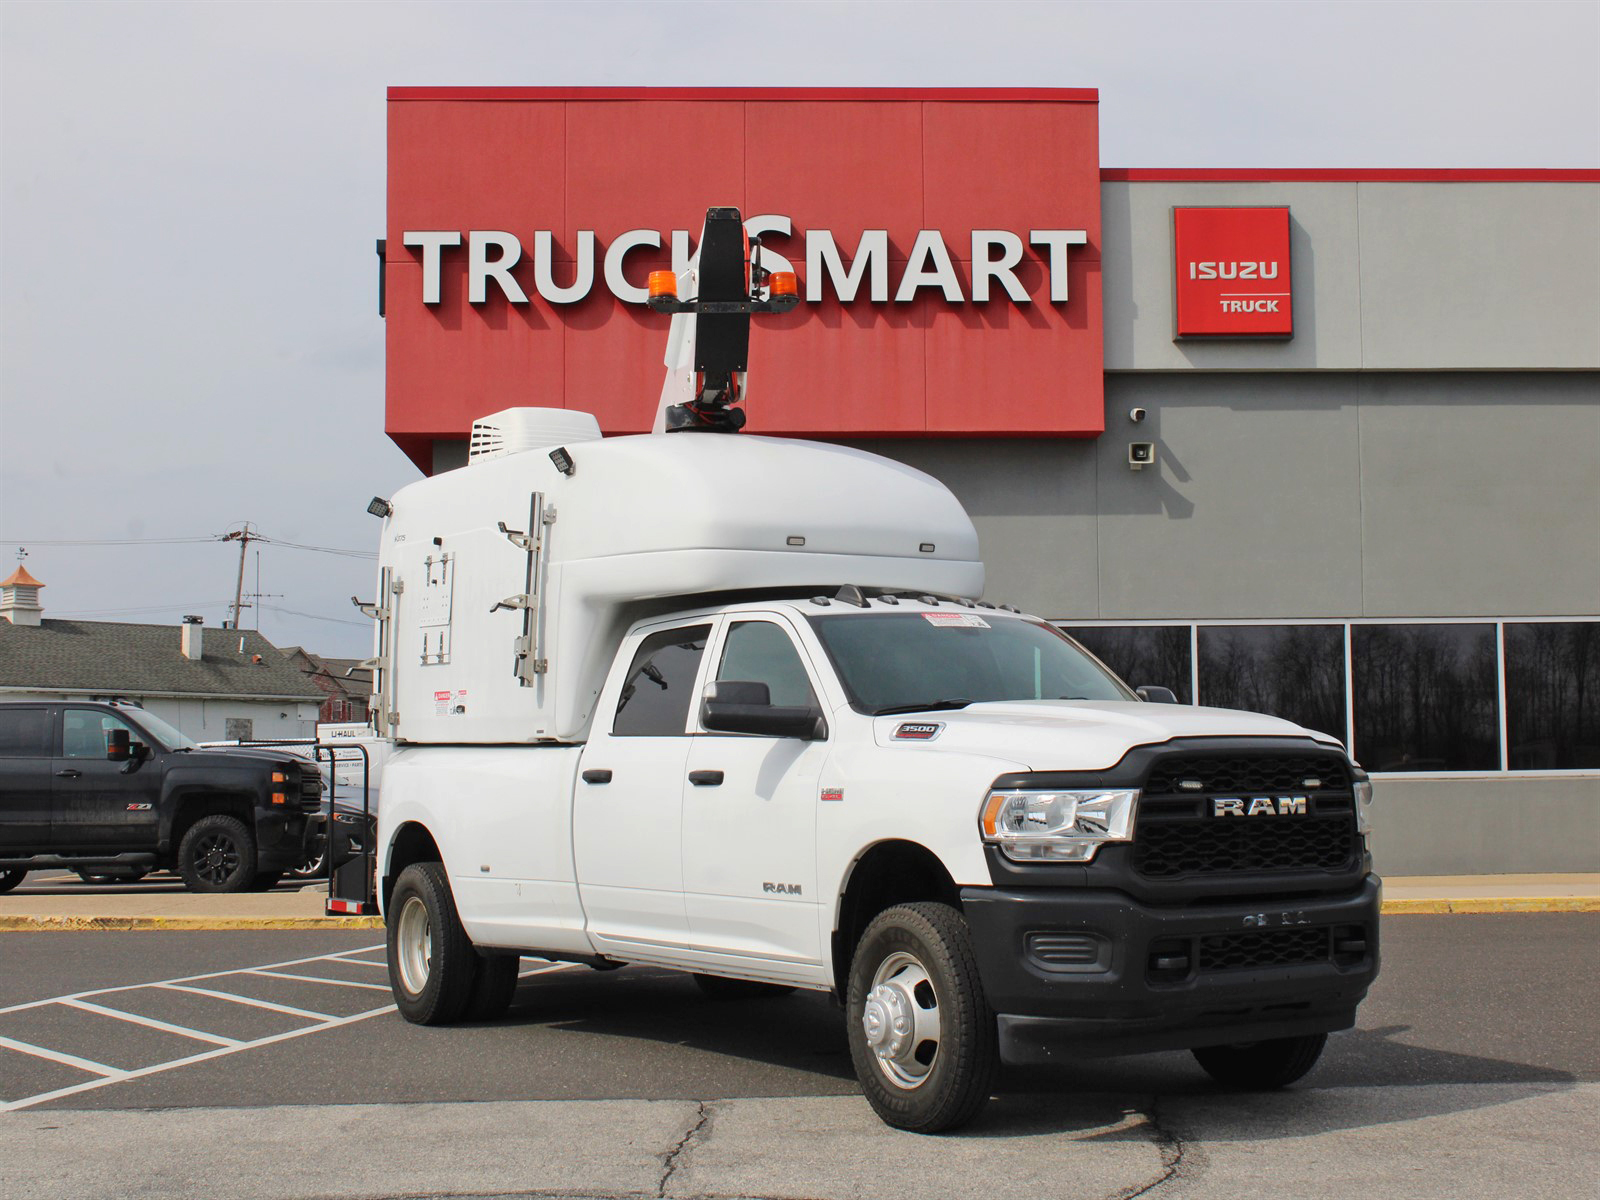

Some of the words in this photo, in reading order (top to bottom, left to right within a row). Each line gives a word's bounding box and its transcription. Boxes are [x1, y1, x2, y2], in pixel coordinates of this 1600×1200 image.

[1189, 261, 1279, 280] ISUZU
[1219, 300, 1280, 313] TRUCK
[1214, 797, 1307, 817] RAM
[763, 882, 802, 895] RAM
